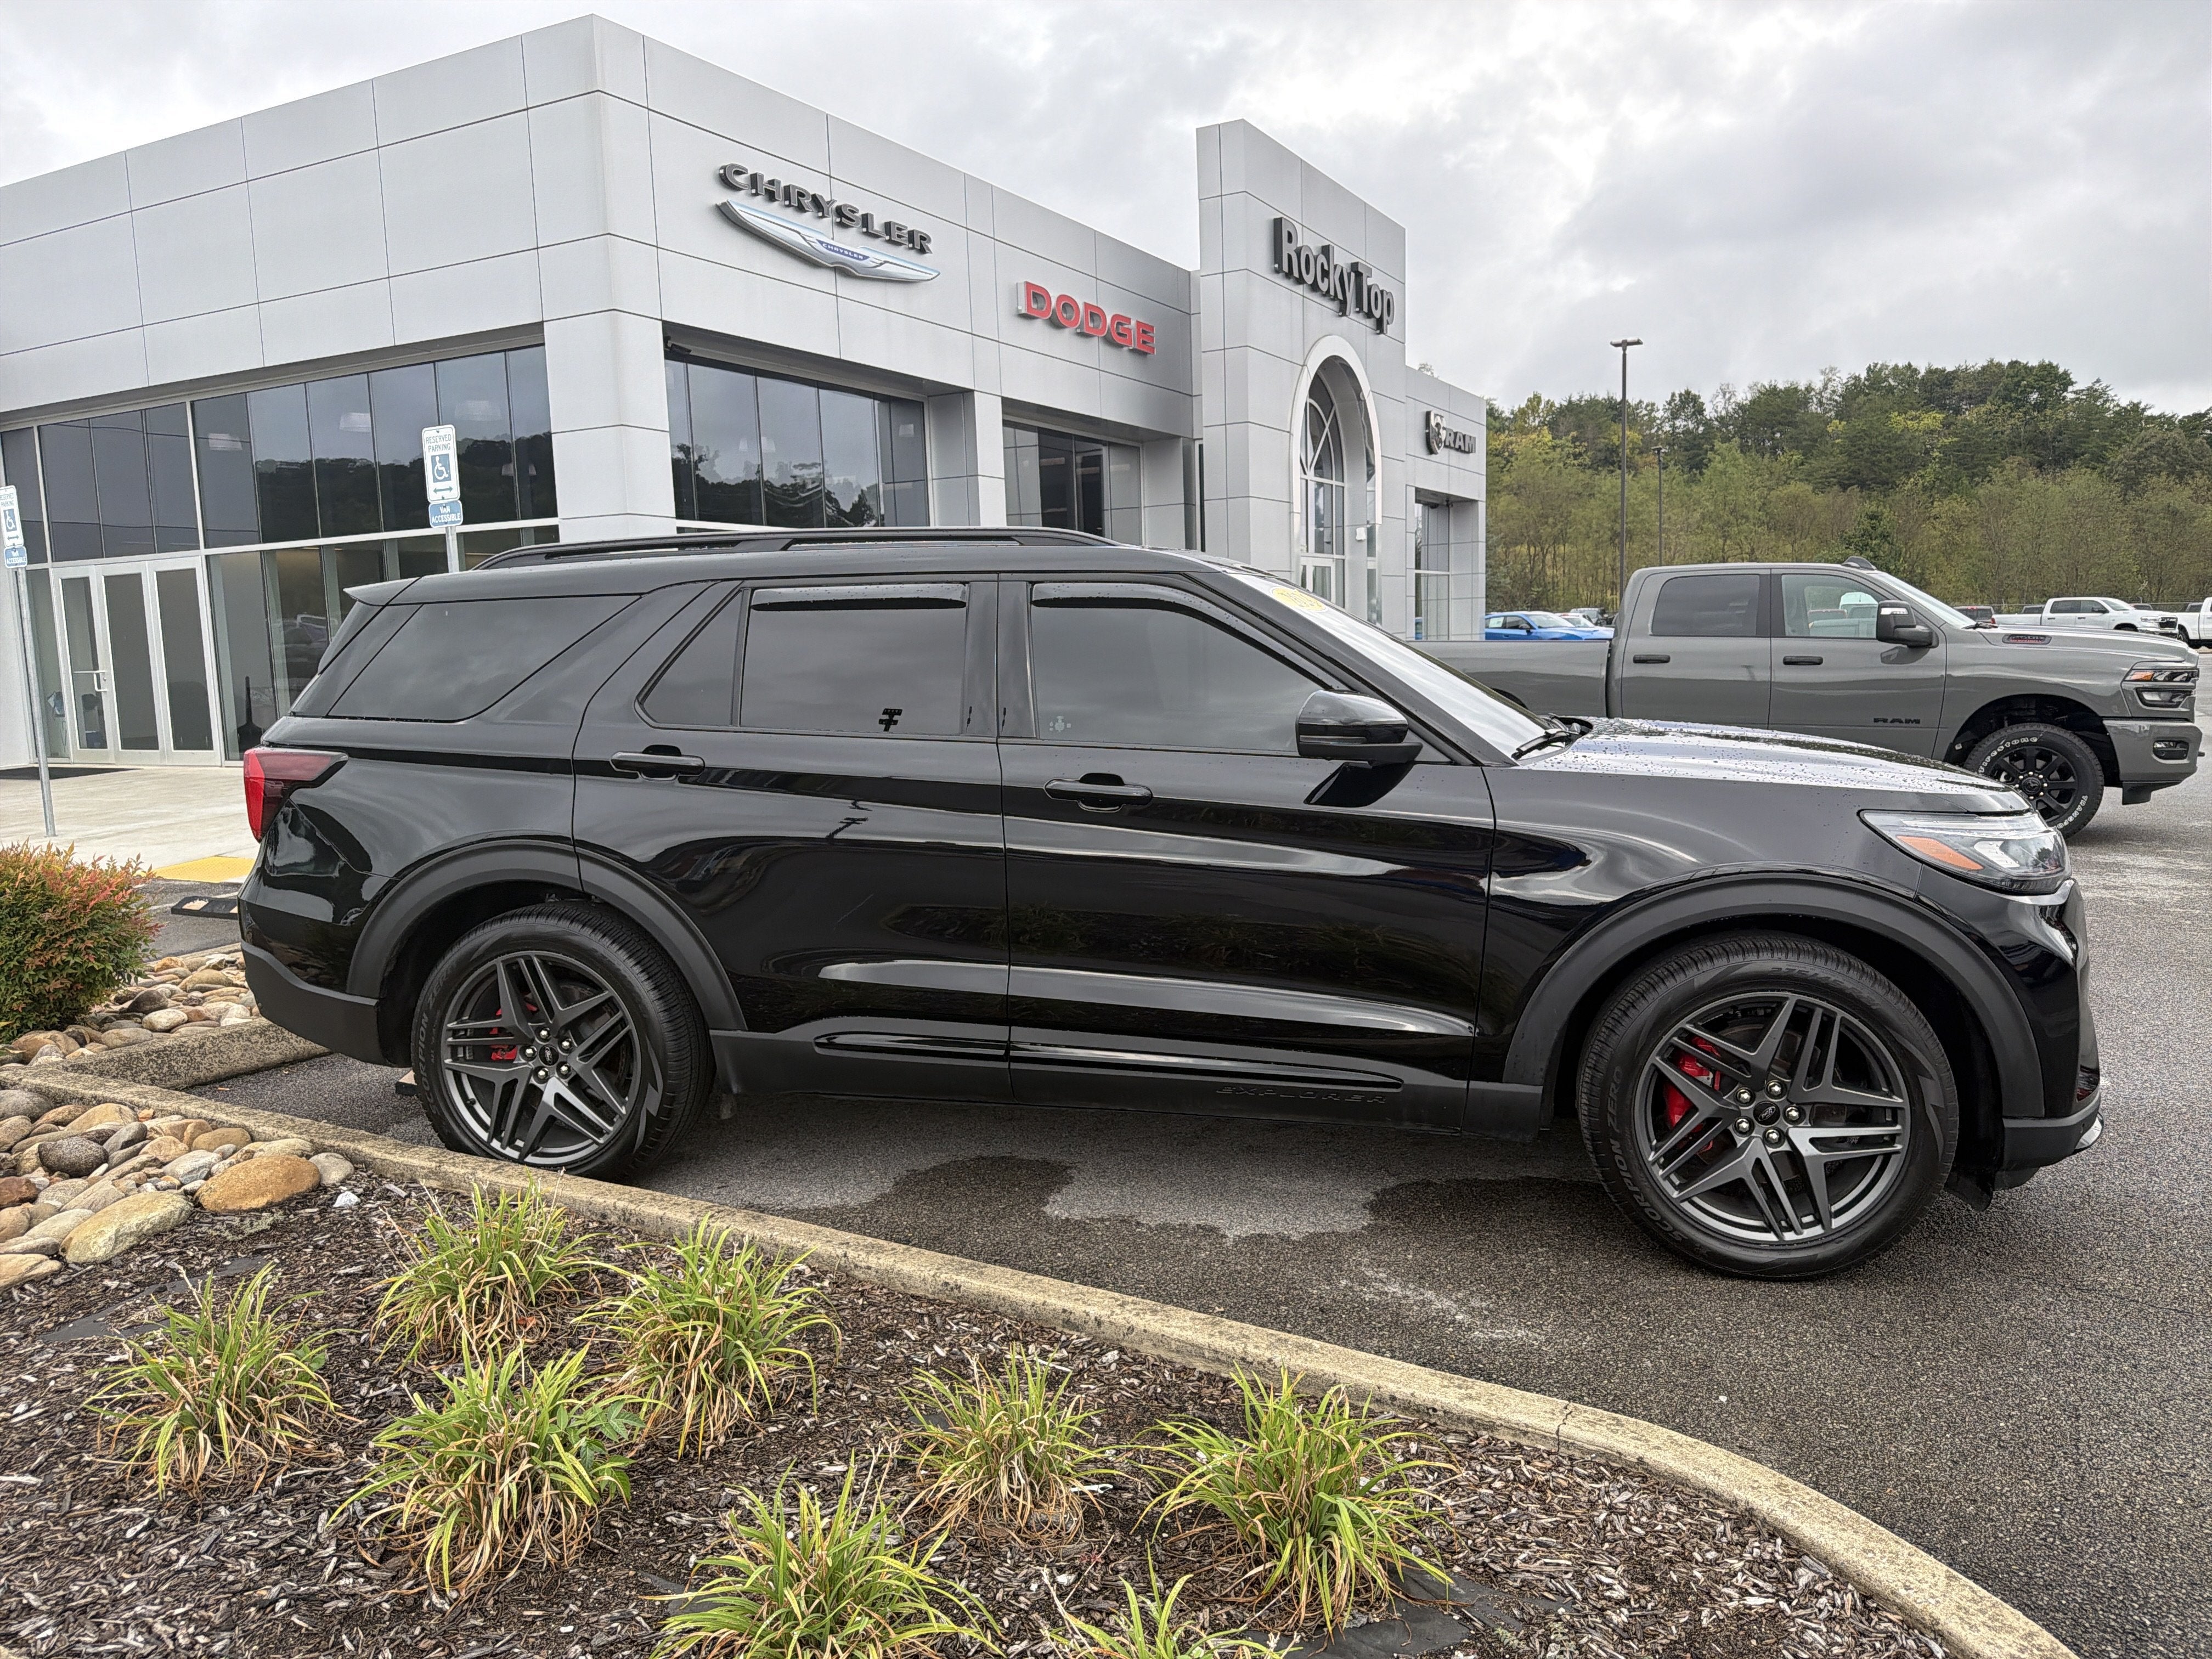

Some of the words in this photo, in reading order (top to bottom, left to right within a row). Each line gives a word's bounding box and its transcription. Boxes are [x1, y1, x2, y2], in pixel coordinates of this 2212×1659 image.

[719, 163, 933, 253] CHRYSLER
[822, 243, 864, 259] CHRYSLER
[1273, 217, 1355, 316] Rocky
[1351, 262, 1396, 335] Top
[1019, 280, 1156, 355] DODGE
[426, 433, 452, 444] RESERVED
[428, 443, 451, 453] PARKING
[1444, 427, 1476, 454] RAM
[432, 512, 461, 523] ACCESSIBLE
[440, 505, 450, 514] VAN
[1607, 1065, 1623, 1132] ZERO
[1610, 1138, 1688, 1240] SCORPION
